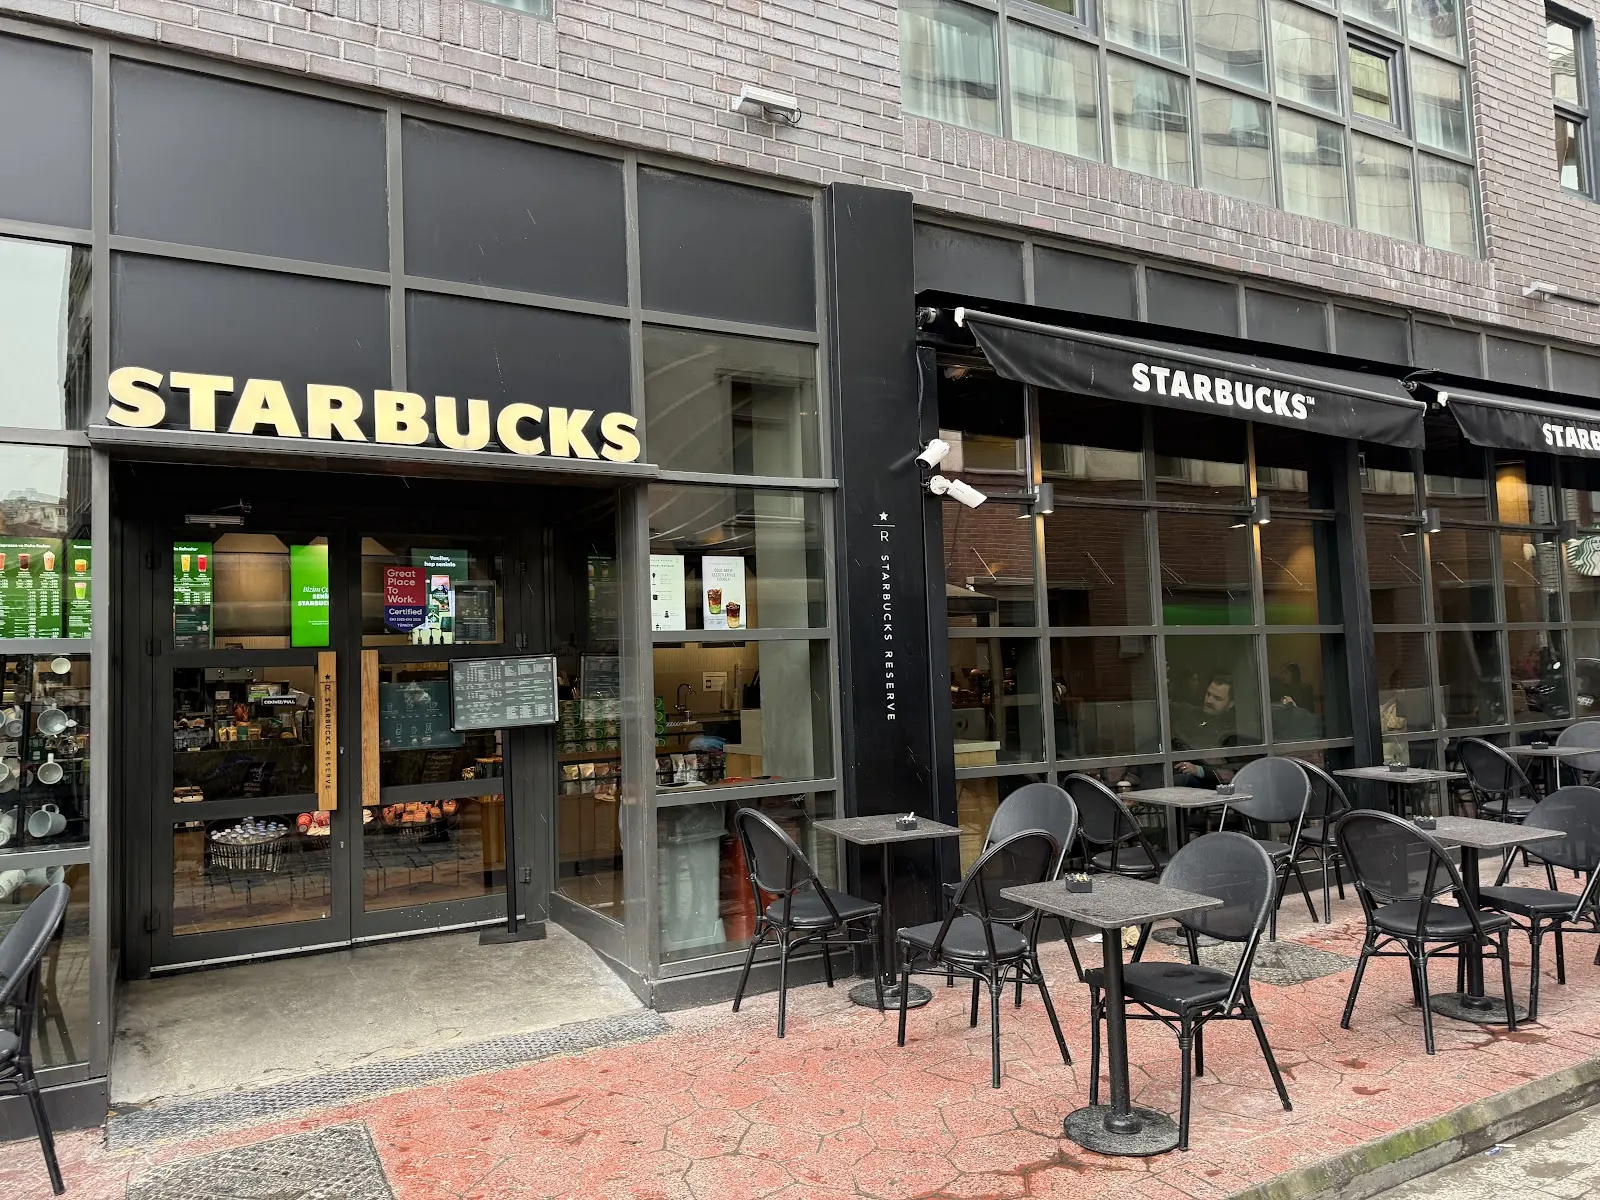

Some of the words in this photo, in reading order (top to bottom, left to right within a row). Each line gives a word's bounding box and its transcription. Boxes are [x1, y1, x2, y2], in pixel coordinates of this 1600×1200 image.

[106, 366, 640, 462] STARBUCKS
[387, 569, 416, 578] Great
[387, 578, 416, 586] Place
[387, 586, 398, 594] To
[881, 554, 893, 641] STARBUCKS
[884, 650, 896, 721] RESERVE
